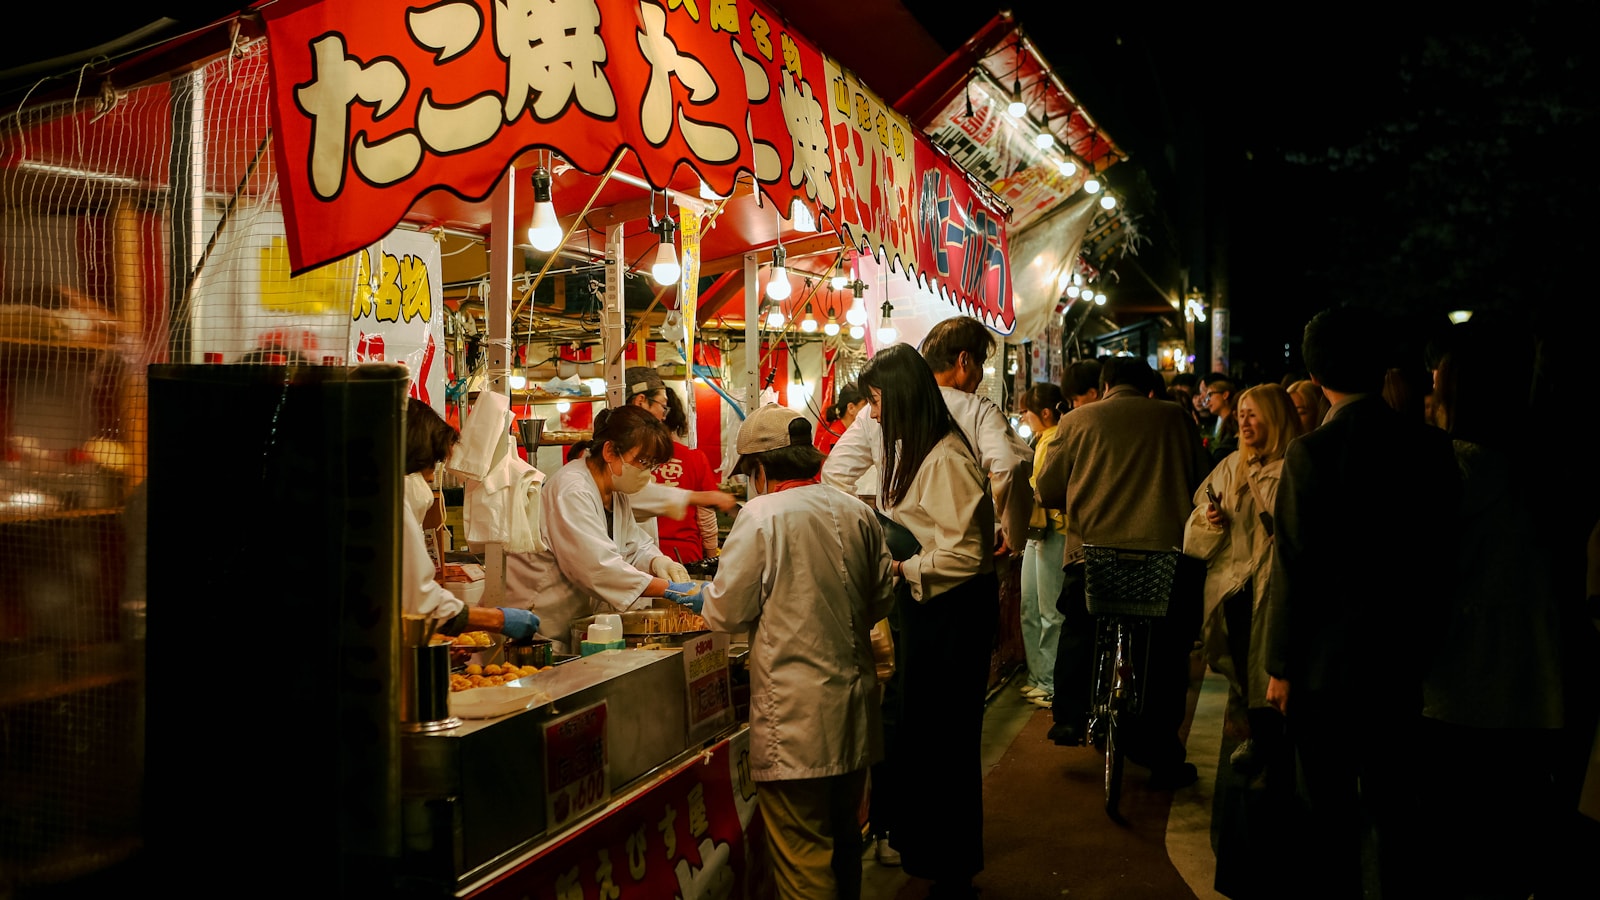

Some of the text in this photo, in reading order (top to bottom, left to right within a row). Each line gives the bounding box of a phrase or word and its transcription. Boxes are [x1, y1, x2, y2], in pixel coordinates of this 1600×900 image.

[293, 0, 618, 200] たこ焼
[834, 76, 905, 161] 山形名物
